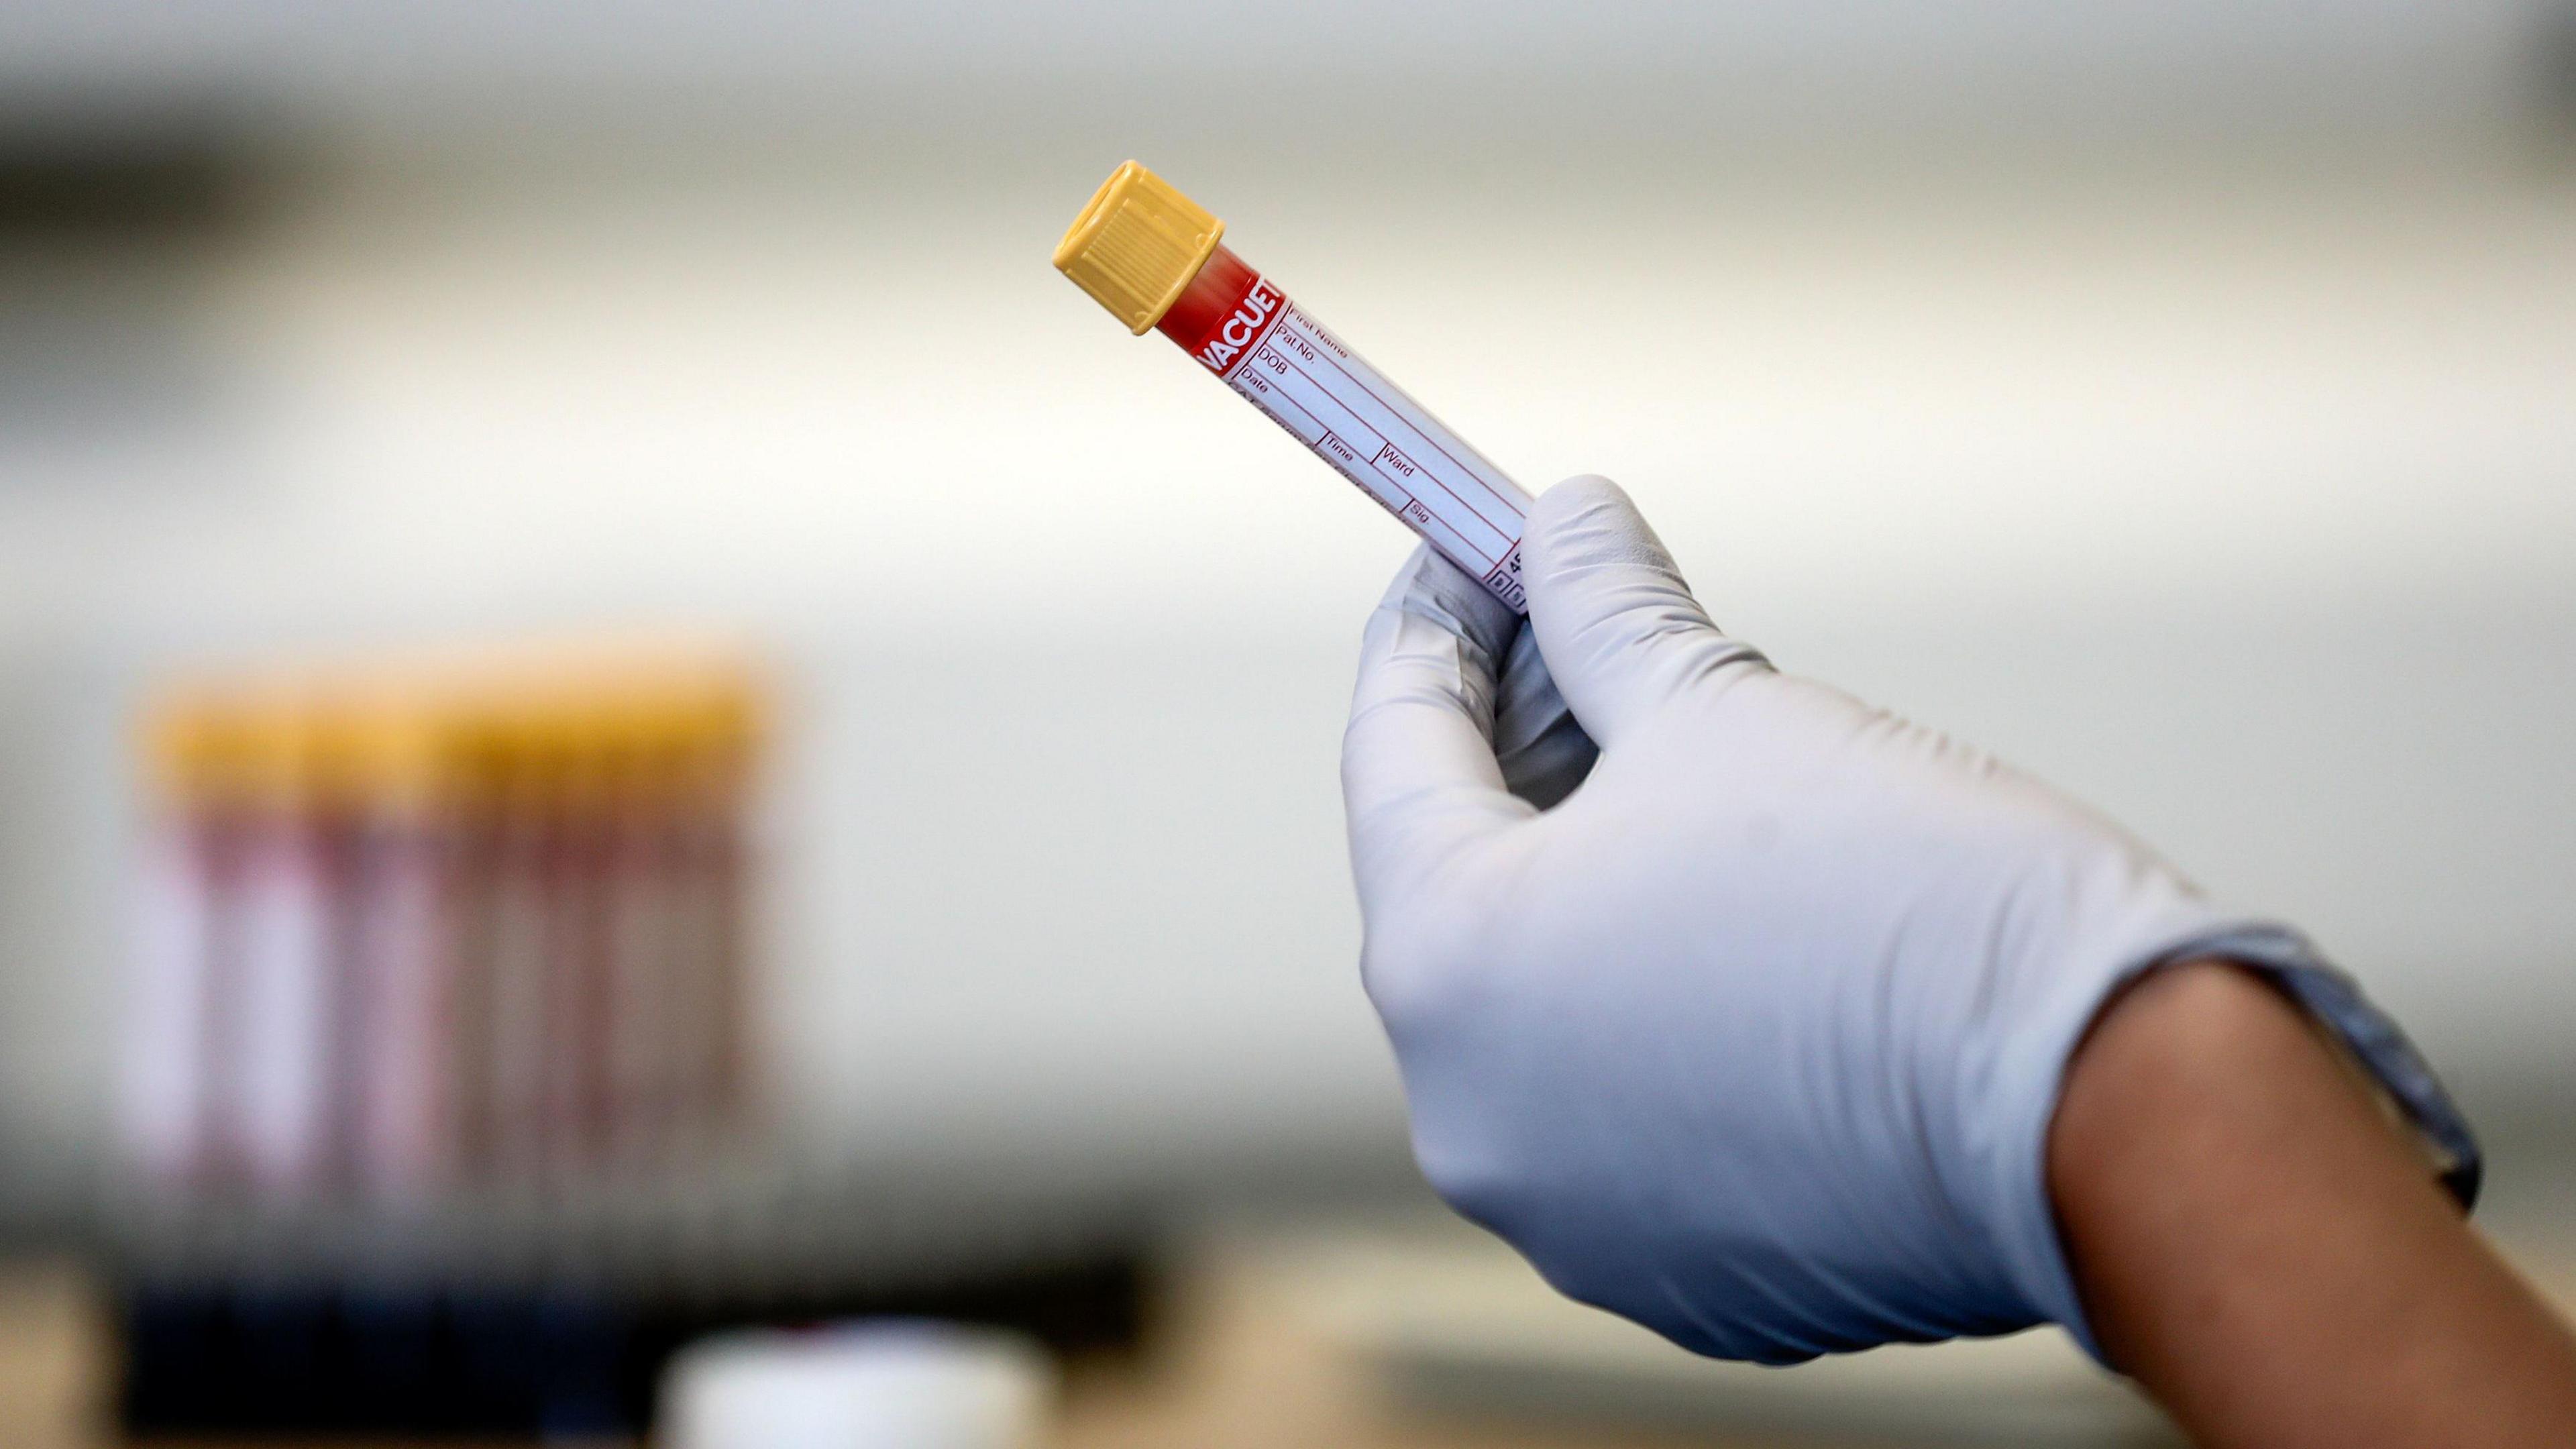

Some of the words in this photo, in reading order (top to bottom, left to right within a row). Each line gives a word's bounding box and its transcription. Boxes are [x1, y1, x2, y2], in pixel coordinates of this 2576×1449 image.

[1275, 326, 1314, 364] Pat.No.
[1315, 329, 1348, 358] Name
[1258, 347, 1287, 374] DOB
[1241, 368, 1268, 392] Date
[1327, 435, 1353, 462] Time
[1383, 447, 1415, 477] Ward
[1410, 504, 1430, 525] Sig.
